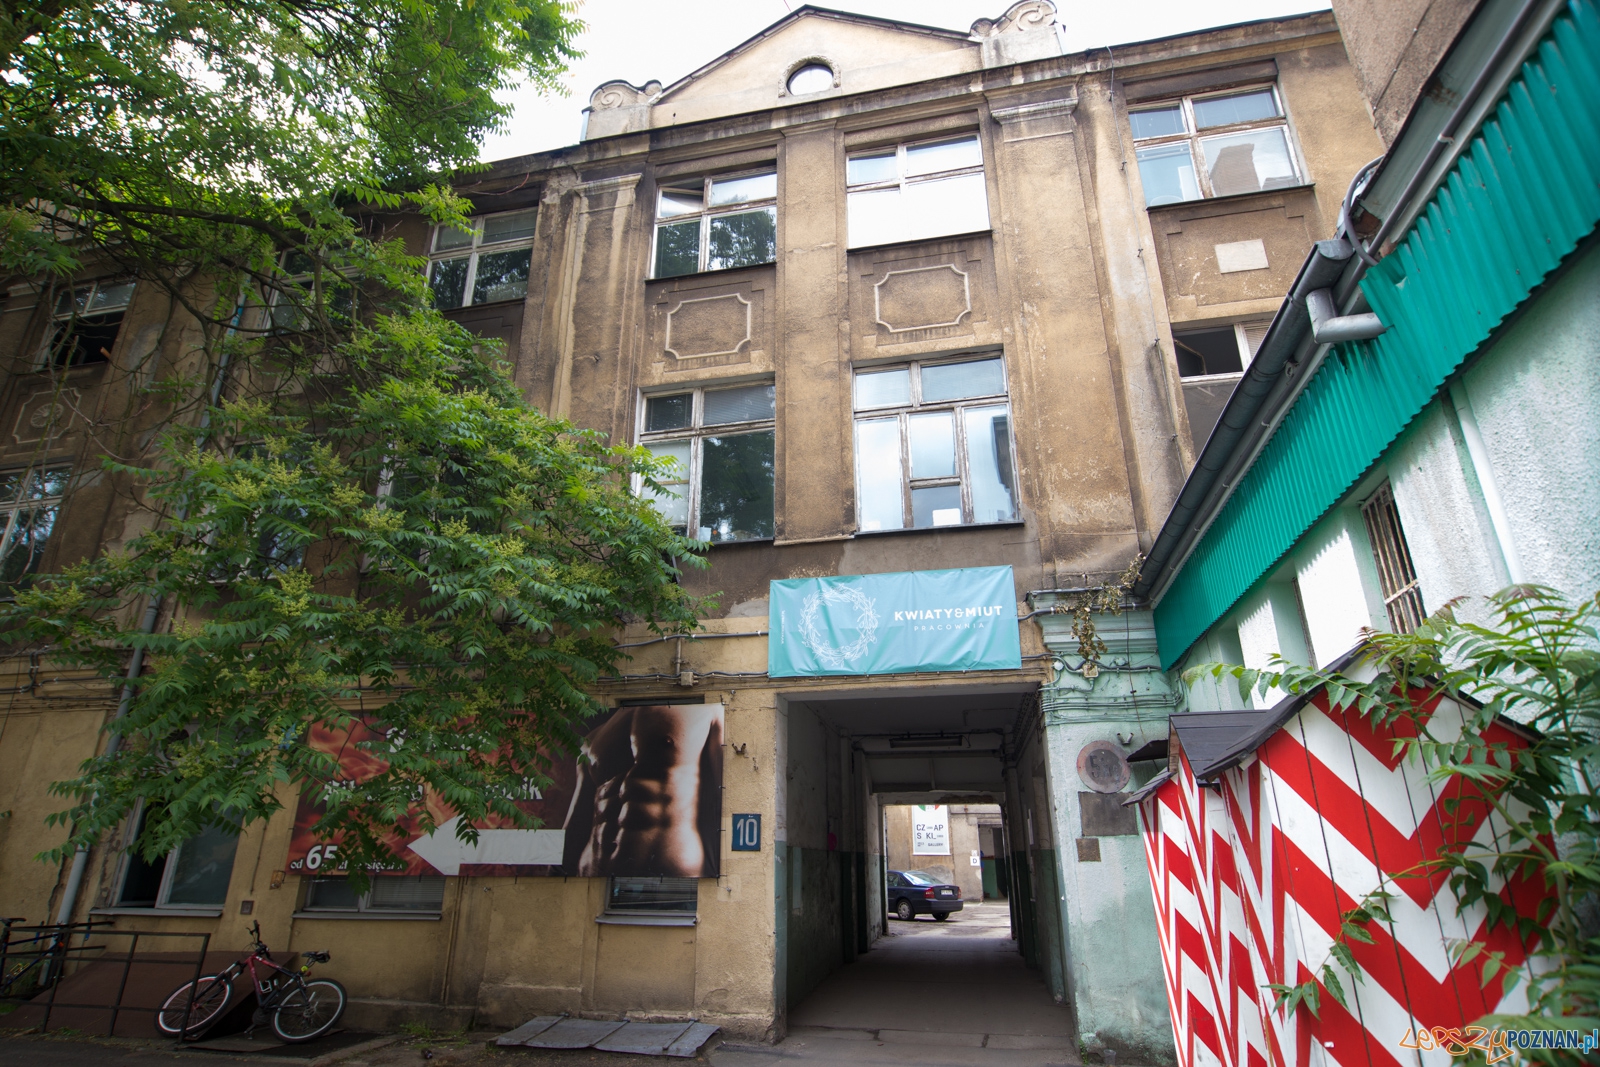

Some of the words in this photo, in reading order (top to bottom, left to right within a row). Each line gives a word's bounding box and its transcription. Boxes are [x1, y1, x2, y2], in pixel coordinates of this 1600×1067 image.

[894, 605, 1002, 621] KWIATY&MIUT
[914, 623, 984, 632] PRACOWNIA
[736, 818, 758, 846] 10
[290, 859, 304, 869] od
